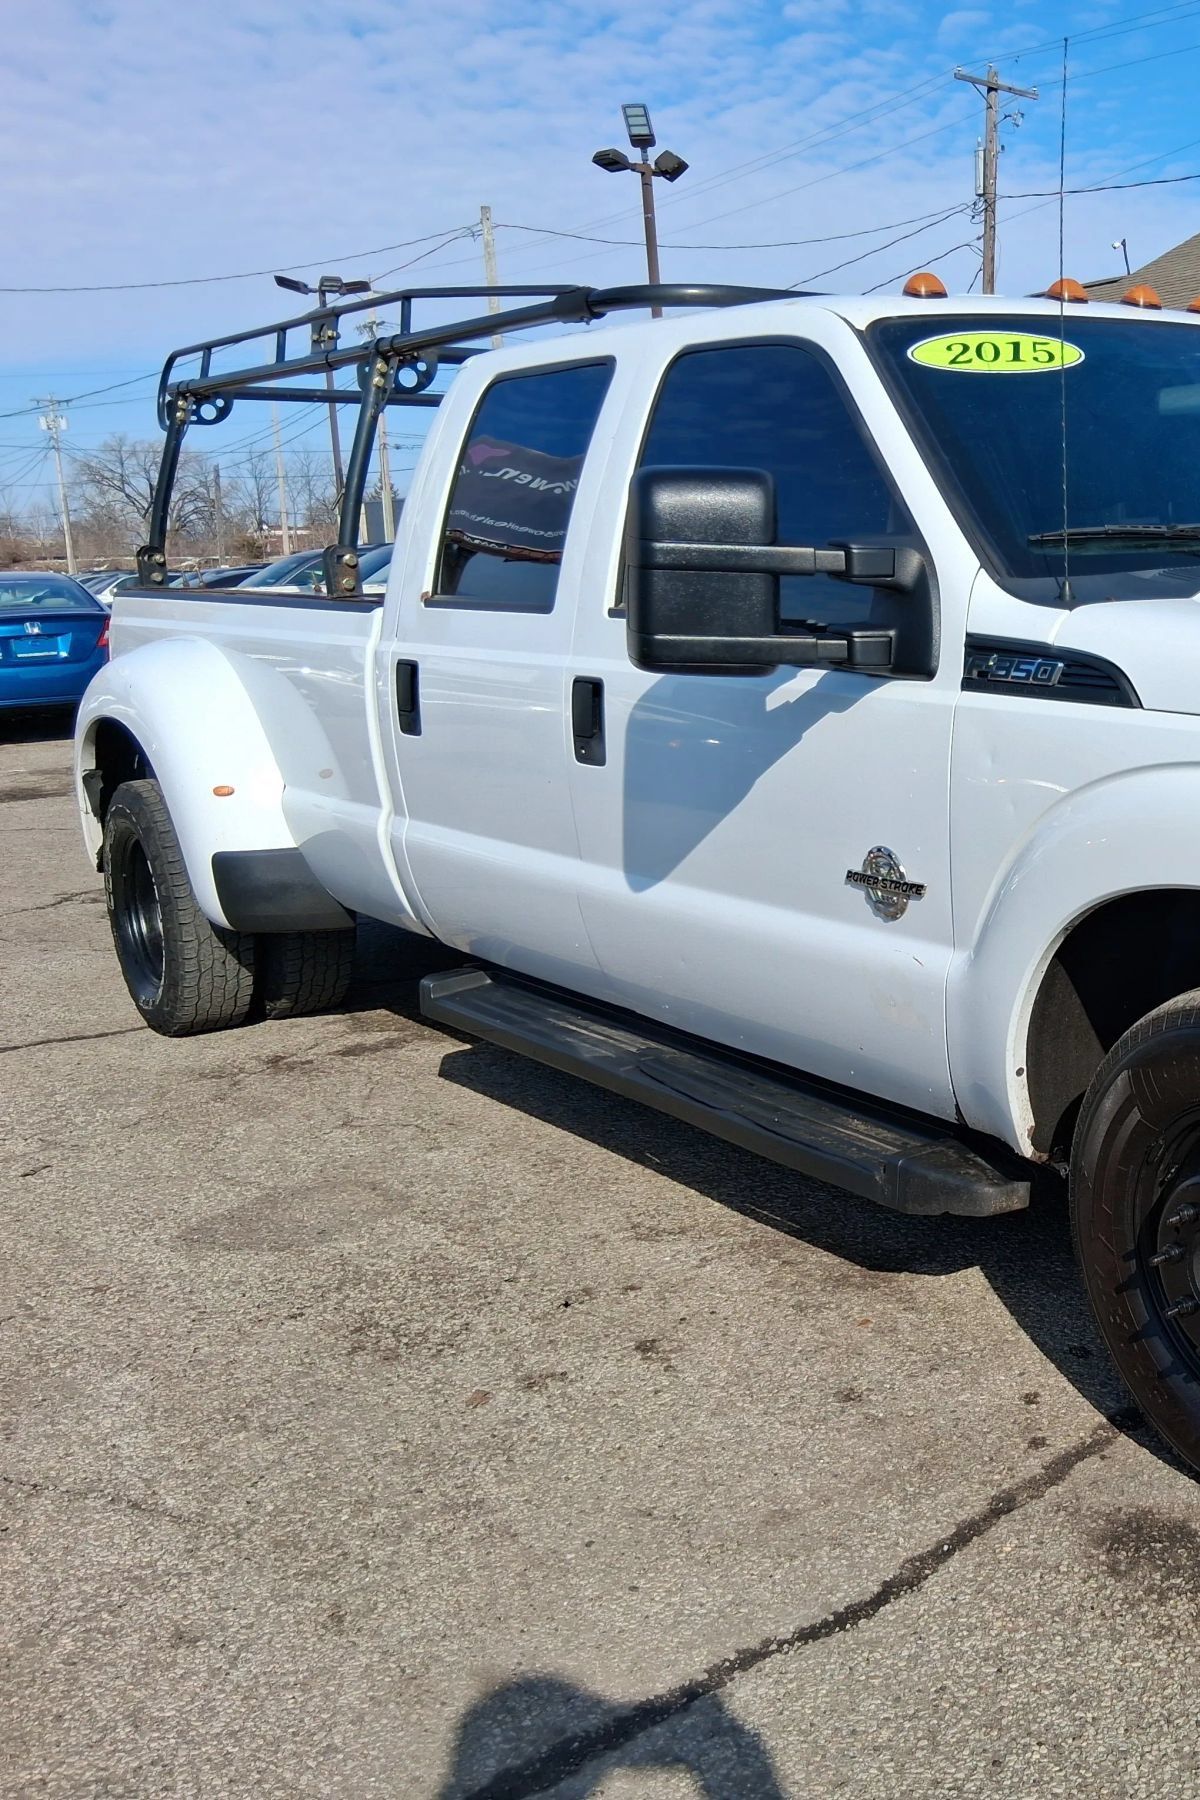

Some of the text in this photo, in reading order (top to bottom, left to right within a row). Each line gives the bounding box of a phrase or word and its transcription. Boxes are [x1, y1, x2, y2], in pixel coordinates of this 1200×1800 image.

[945, 341, 1056, 365] 2015
[846, 870, 924, 895] POWER STROKE
